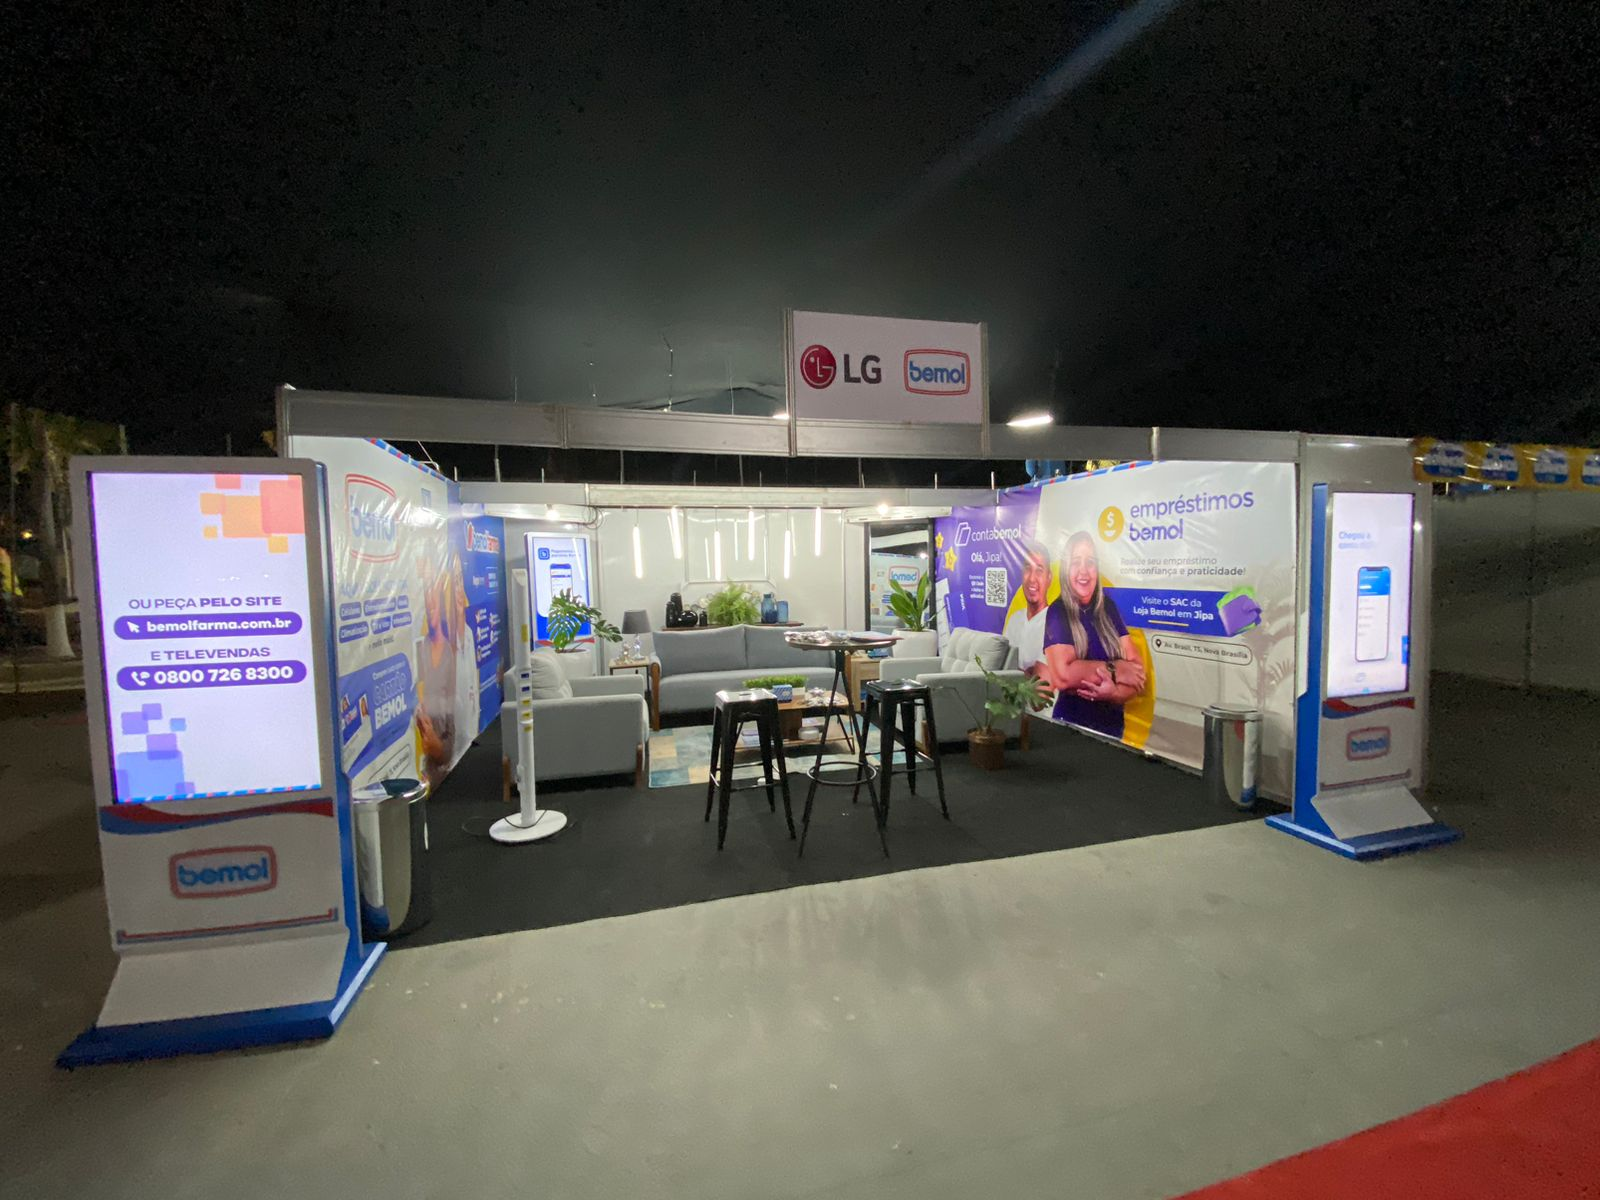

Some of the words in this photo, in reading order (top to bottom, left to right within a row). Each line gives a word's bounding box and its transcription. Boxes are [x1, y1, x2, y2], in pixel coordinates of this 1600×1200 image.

[843, 353, 882, 384] LG
[909, 360, 966, 385] bemol
[1130, 491, 1255, 519] empréstimos
[1129, 518, 1184, 541] bemol
[1147, 558, 1160, 566] seu
[1137, 566, 1178, 577] confiança
[128, 598, 151, 610] OU
[154, 597, 197, 611] PEÇA
[199, 596, 243, 608] PELO
[245, 595, 282, 607] SITE
[1141, 595, 1162, 606] Visite
[1169, 597, 1189, 607] SAC
[1190, 599, 1202, 608] da
[1133, 605, 1149, 616] Loja
[1150, 606, 1176, 617] Bemol
[1177, 610, 1192, 619] em
[1193, 610, 1215, 621] Jipa
[146, 617, 292, 633] bemolfarma.com.br
[151, 650, 161, 661] E
[164, 647, 271, 661] TELEVENDAS
[153, 669, 205, 685] 0800
[207, 667, 242, 682] 726
[245, 665, 294, 681] 8300
[374, 692, 407, 730] BEMOL
[178, 857, 270, 886] bemol
